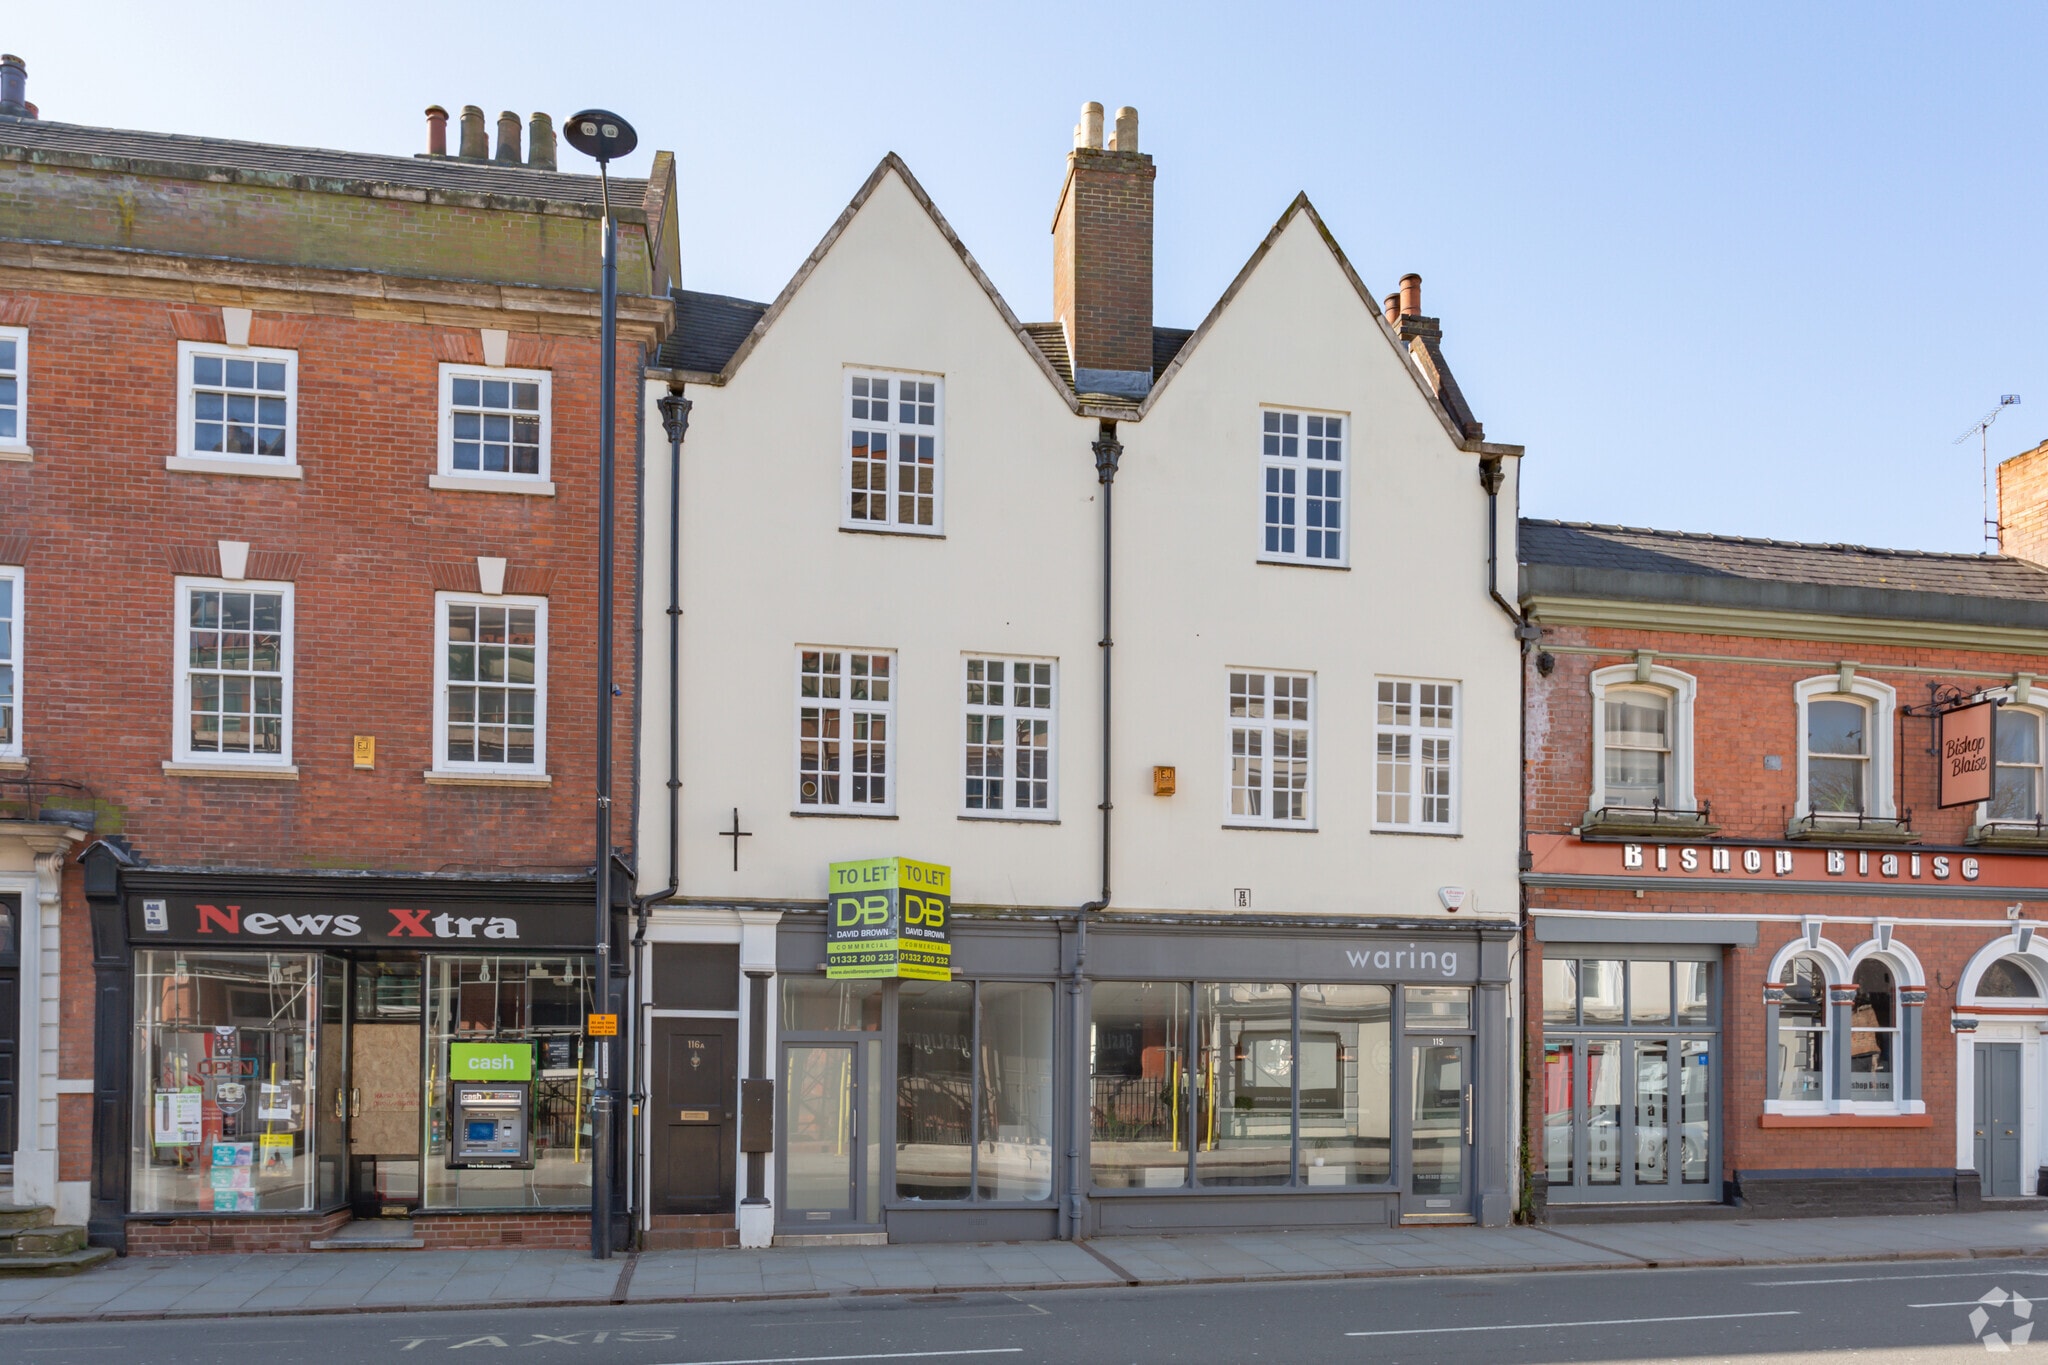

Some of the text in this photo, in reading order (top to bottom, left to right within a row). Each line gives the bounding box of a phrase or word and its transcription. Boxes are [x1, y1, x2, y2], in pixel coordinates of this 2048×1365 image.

[1946, 736, 1985, 759] Bishop
[1952, 754, 1987, 777] Blaise
[1624, 844, 1979, 881] Bishop Blaise
[838, 866, 890, 884] TO LET
[906, 865, 945, 886] TO LET
[1239, 899, 1247, 907] 15
[837, 896, 889, 927] DB
[905, 895, 945, 928] DB
[196, 904, 520, 939] News Xtra
[837, 929, 889, 939] DAVID BROWN
[905, 927, 945, 939] DAVID BROWN
[837, 942, 888, 951] COMMERCIAL
[905, 942, 944, 952] COMMERCIAL
[831, 954, 894, 964] 01332 200 232
[900, 953, 949, 965] 01332 200 232
[1346, 943, 1457, 977] waring
[688, 1040, 705, 1049] 116A
[1433, 1038, 1444, 1046] 115
[197, 1061, 254, 1075] OPEN
[468, 1054, 514, 1070] cash
[463, 1093, 482, 1101] cash
[390, 1327, 679, 1350] TAXIS
